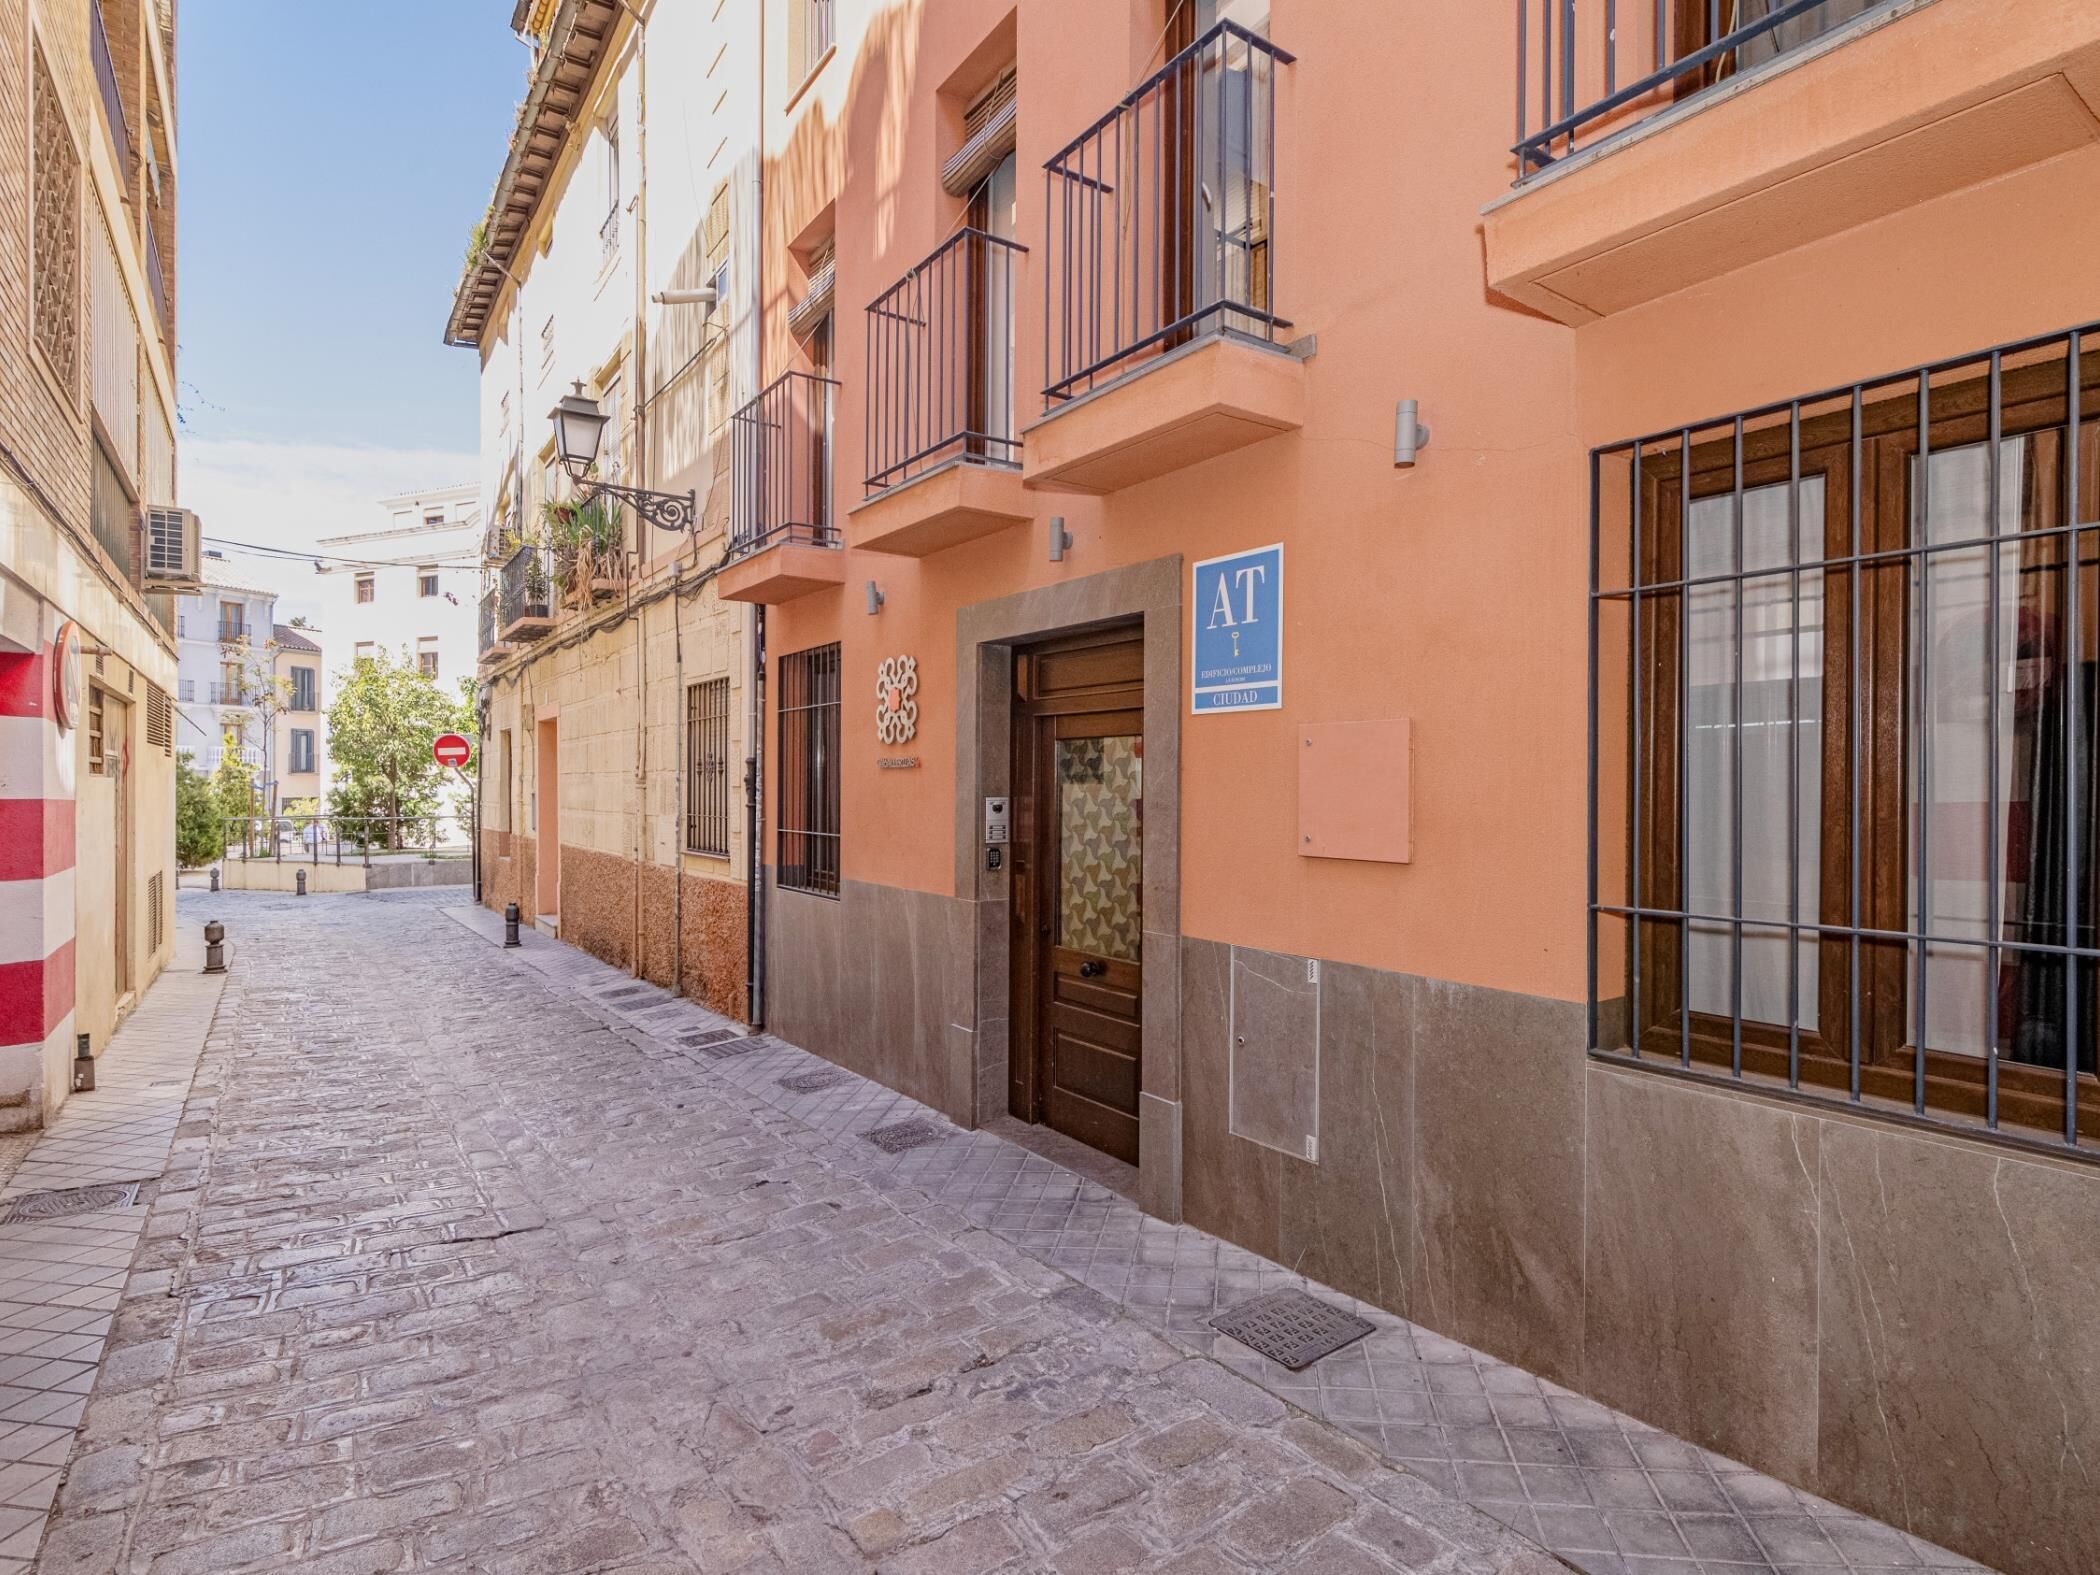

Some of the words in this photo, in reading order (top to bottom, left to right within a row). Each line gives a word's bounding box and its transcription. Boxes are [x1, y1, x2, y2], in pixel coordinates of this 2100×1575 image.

[1206, 565, 1265, 630] AT
[1201, 664, 1271, 679] EDIFICIO/COMPLEJO
[1213, 690, 1257, 706] CIUDAD
